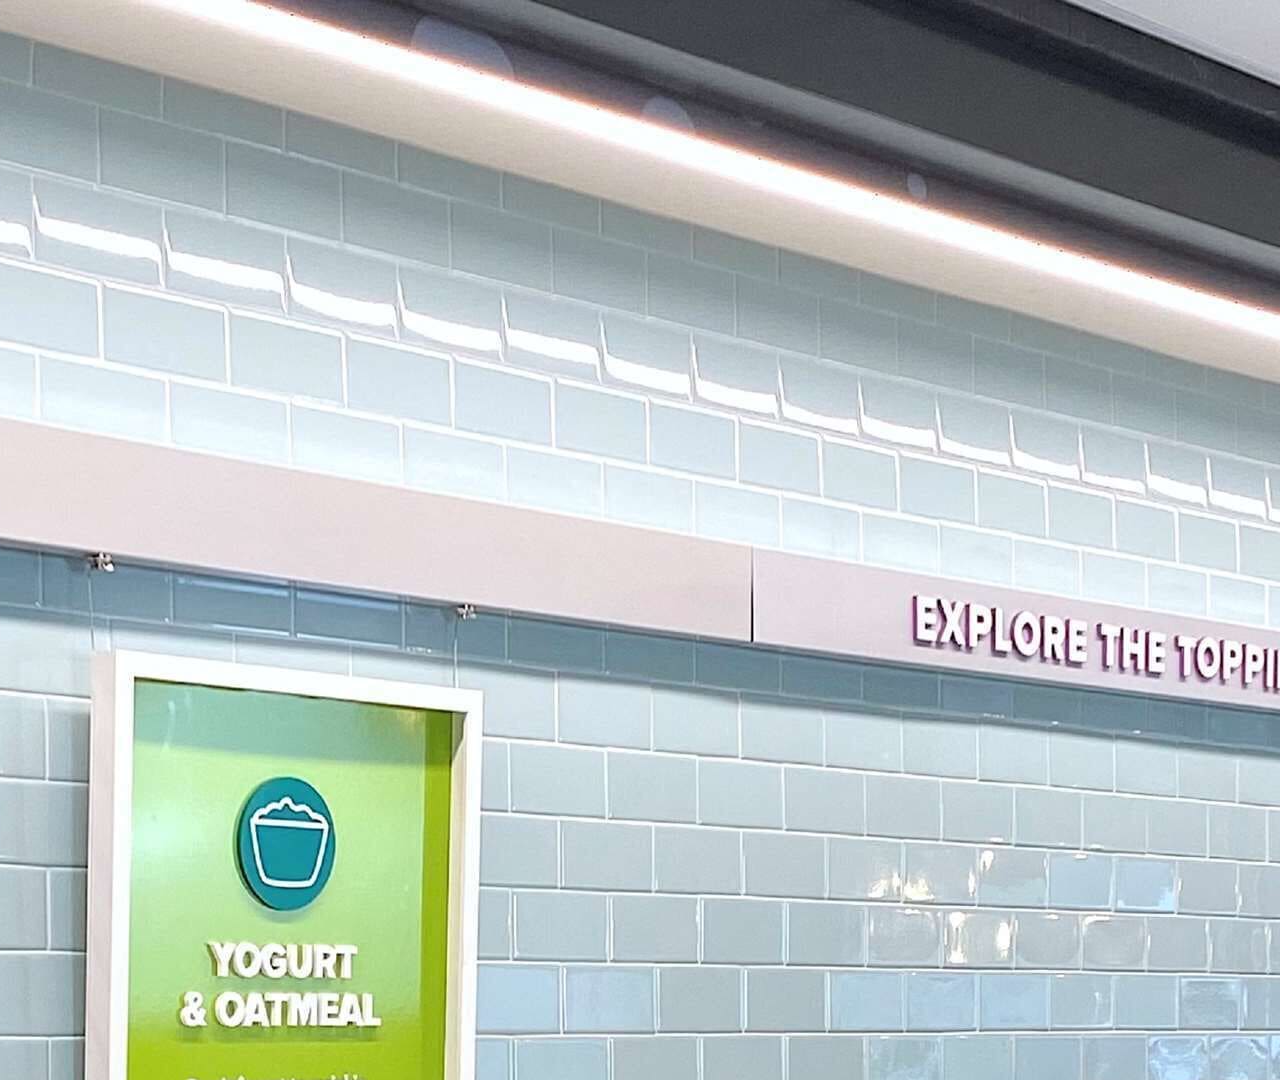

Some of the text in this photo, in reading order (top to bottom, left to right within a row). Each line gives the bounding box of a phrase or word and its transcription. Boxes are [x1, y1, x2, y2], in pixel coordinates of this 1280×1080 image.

[913, 594, 1088, 663] EXPLORE
[1096, 622, 1166, 675] THE
[208, 942, 359, 980] YOGURT
[180, 991, 382, 1028] & OATMEAL
